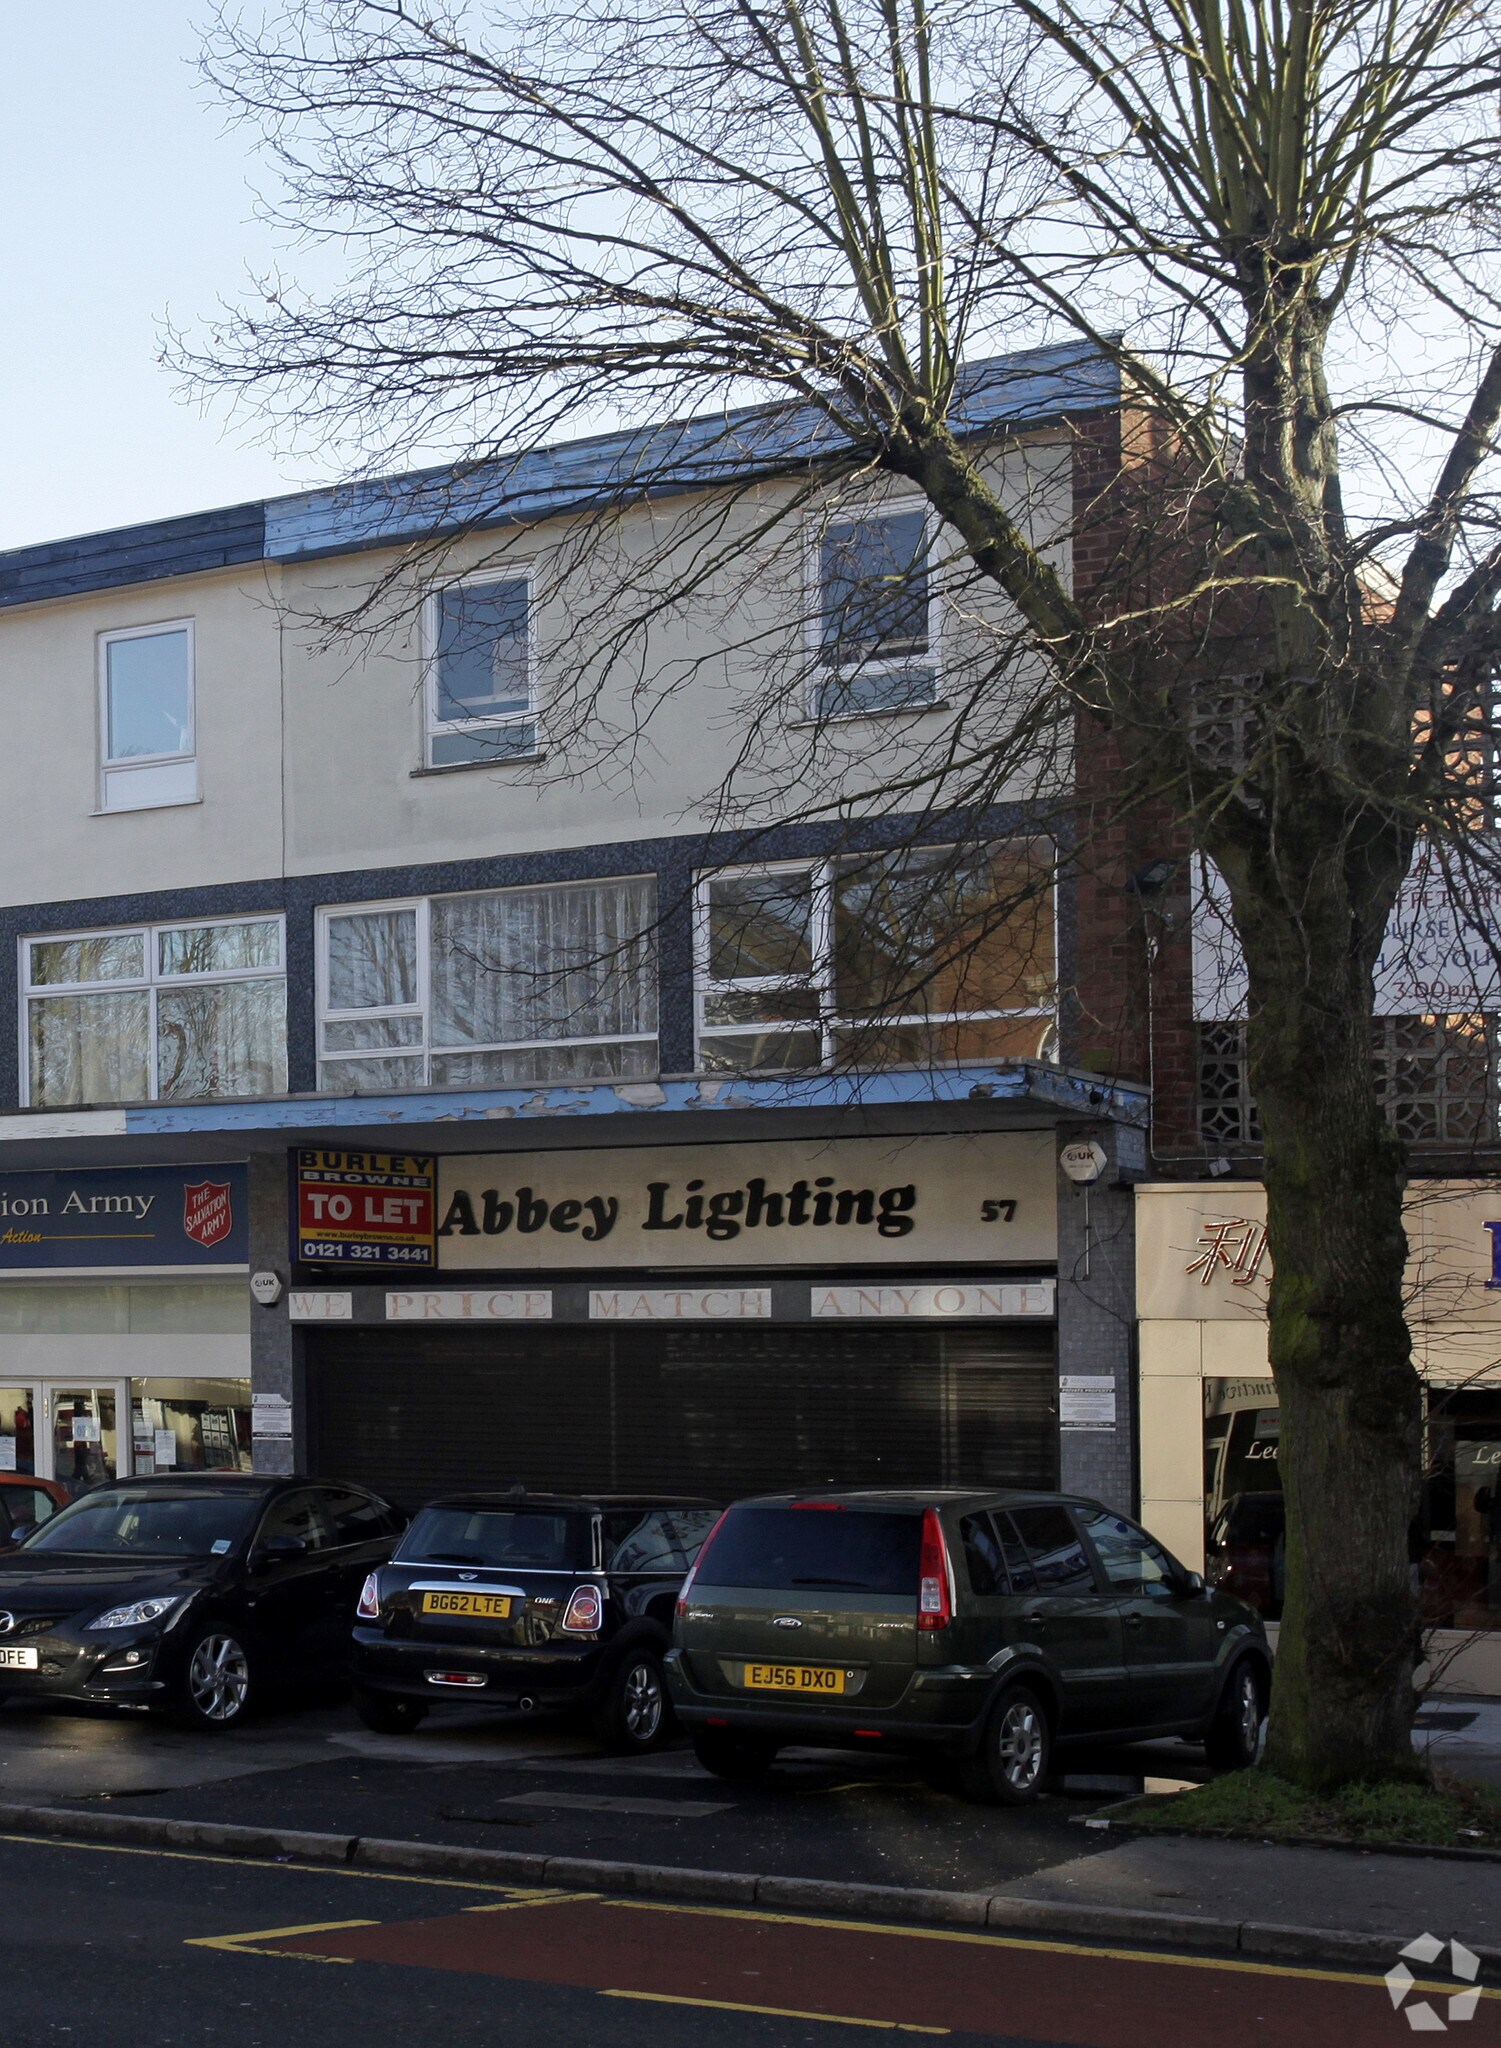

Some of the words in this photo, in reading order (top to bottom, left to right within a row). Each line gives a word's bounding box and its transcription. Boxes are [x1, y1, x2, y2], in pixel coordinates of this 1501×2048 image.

[1217, 960, 1247, 977] EA
[1437, 949, 1491, 968] YOU
[300, 1151, 430, 1175] BURLEY
[303, 1171, 429, 1187] BROWNE
[60, 1190, 156, 1219] Army
[192, 1187, 210, 1209] THE
[307, 1193, 353, 1221] TO
[364, 1196, 424, 1224] LET
[437, 1187, 619, 1241] Abbey
[642, 1176, 916, 1240] Lighting
[186, 1190, 226, 1232] SALVATION
[980, 1199, 1018, 1222] 57
[0, 1227, 43, 1244] Action
[201, 1209, 226, 1240] ARMY
[316, 1231, 416, 1242] www.burleybrowne.co.uk
[303, 1243, 343, 1257] 0121
[350, 1245, 380, 1259] 321
[387, 1247, 429, 1261] 3441
[1185, 1219, 1273, 1285] 利
[291, 1293, 346, 1318] WE
[389, 1292, 549, 1318] PRICE
[593, 1290, 764, 1318] MATCH
[816, 1286, 1048, 1315] ANYONE
[430, 1594, 469, 1611] BG62
[473, 1597, 504, 1614] LTE
[751, 1666, 796, 1686] EJ56
[800, 1668, 836, 1688] DXO
